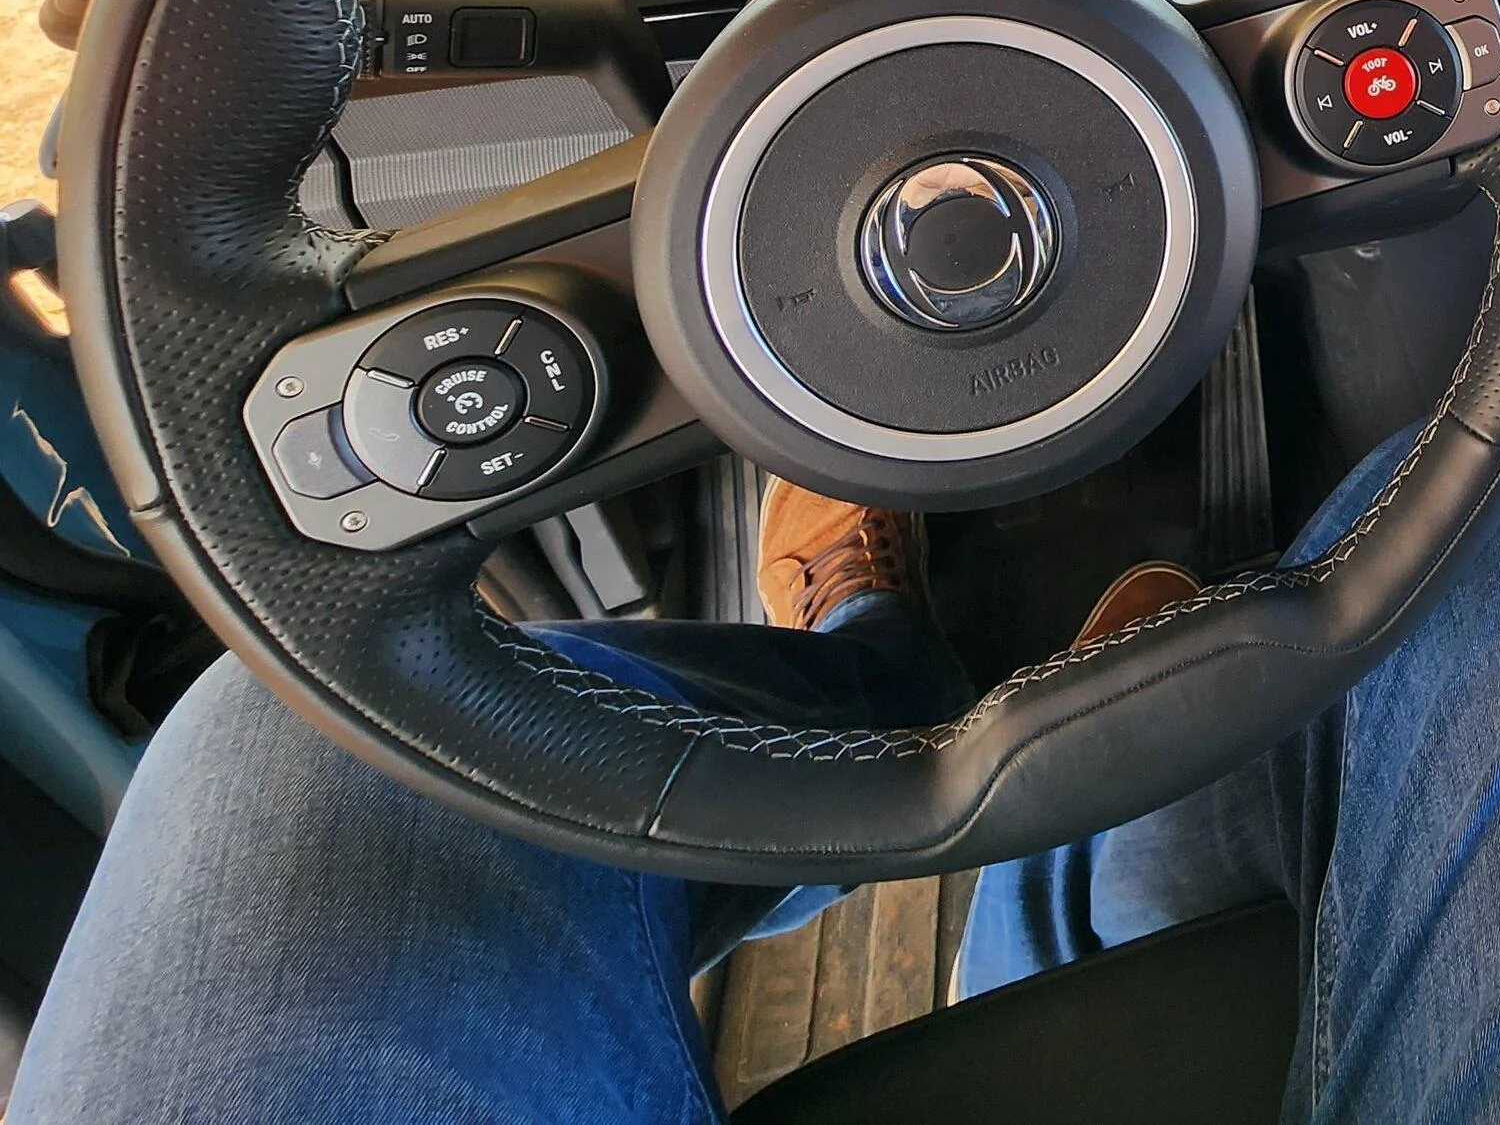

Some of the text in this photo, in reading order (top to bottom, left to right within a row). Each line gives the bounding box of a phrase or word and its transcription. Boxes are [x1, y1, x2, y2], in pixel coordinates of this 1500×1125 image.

[402, 13, 432, 25] AUTO
[1347, 22, 1378, 39] VOL+
[1474, 44, 1489, 58] OK
[1361, 58, 1388, 73] TOOT
[423, 327, 470, 351] RES+
[434, 370, 487, 396] CRUISE
[540, 350, 566, 392] CNL
[969, 347, 1061, 396] AIRBAG
[445, 403, 509, 435] CONTROL
